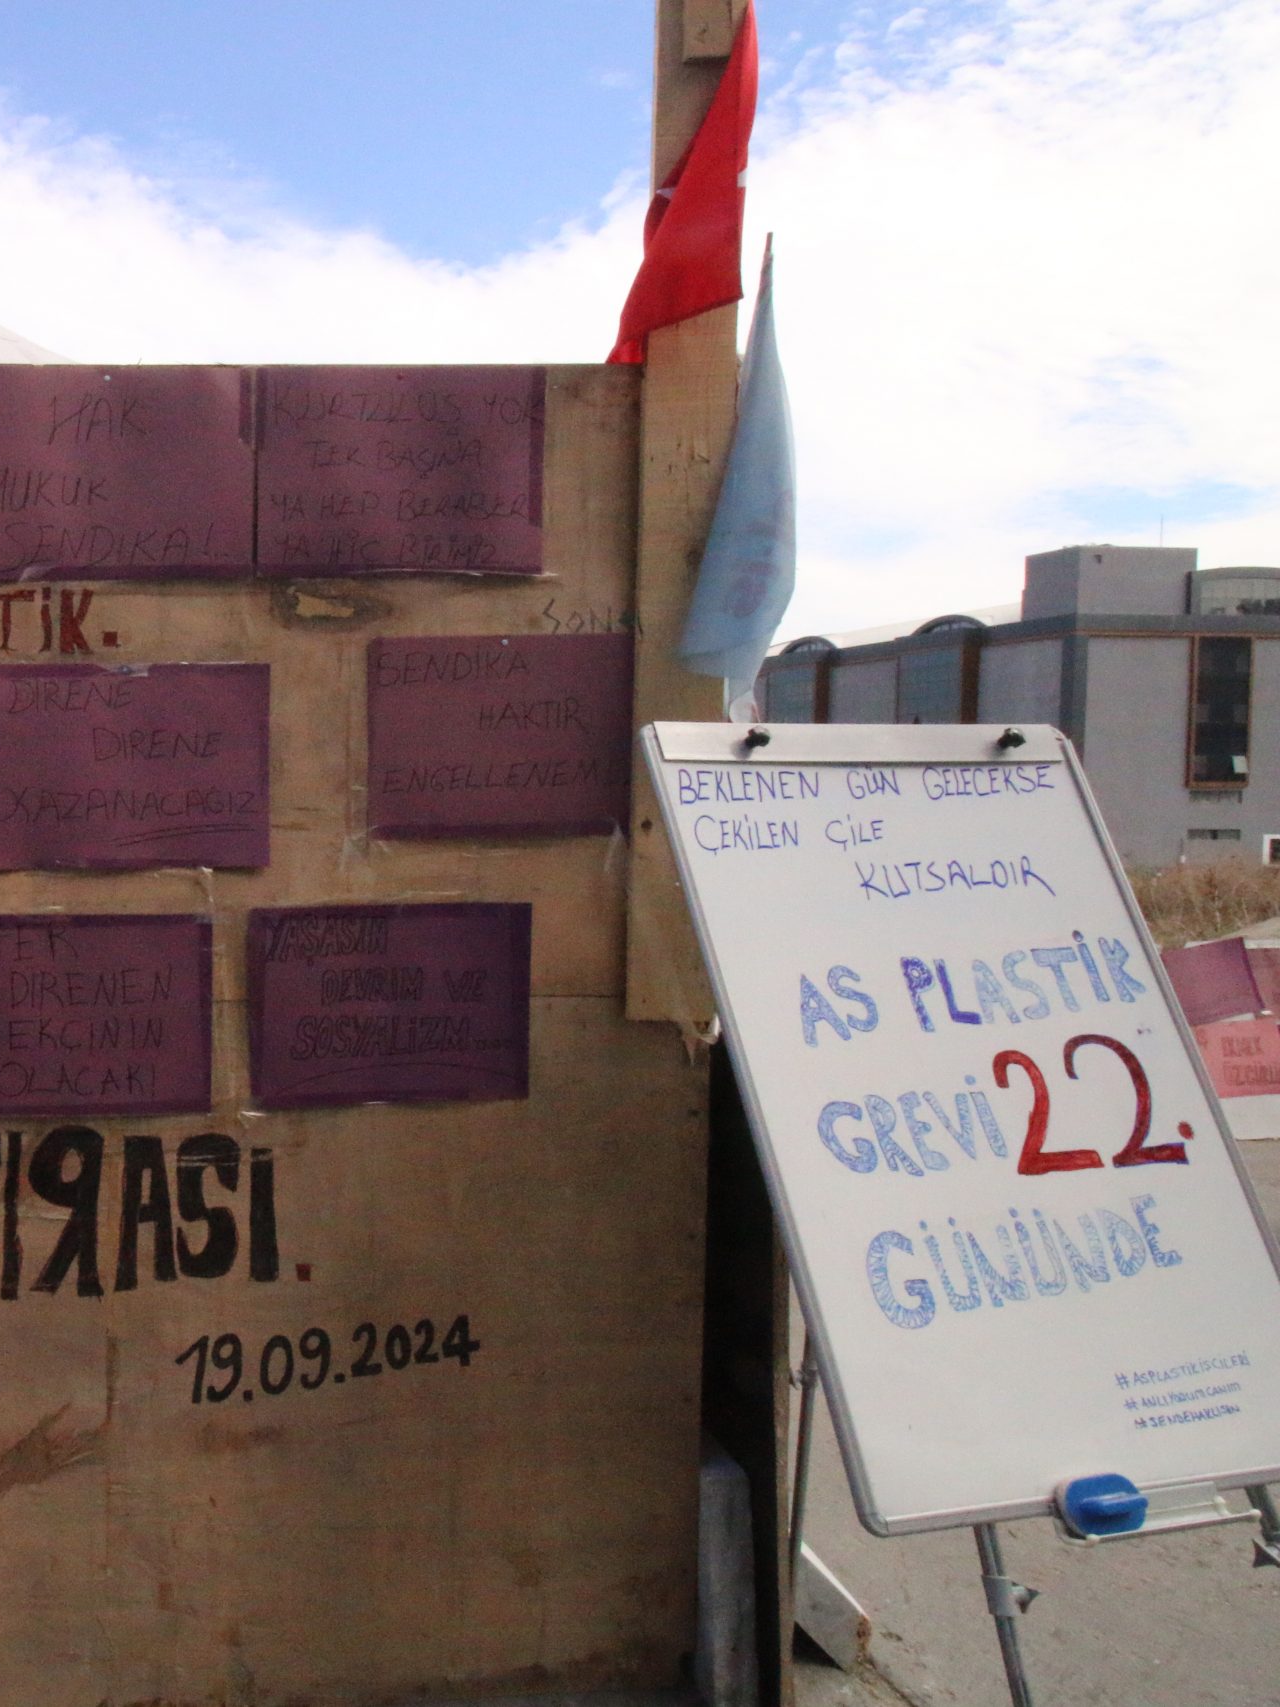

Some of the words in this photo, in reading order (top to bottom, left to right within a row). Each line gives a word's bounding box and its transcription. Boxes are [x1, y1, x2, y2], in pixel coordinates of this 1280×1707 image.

[47, 392, 150, 445] HAK
[483, 393, 545, 425] YOK
[306, 439, 364, 470] TEK
[271, 493, 305, 521] YA
[320, 491, 379, 519] HEP
[397, 488, 528, 522] BERABER
[274, 533, 309, 563] YA
[478, 697, 590, 731] HAKTIR
[678, 769, 820, 805] BEKLENEN
[846, 766, 901, 797] GÜN
[923, 764, 1055, 801] GELECEKSE
[855, 855, 1056, 900] KUTSALDIR
[444, 968, 487, 1003] VE
[800, 964, 879, 1047] AS
[992, 1033, 1194, 1175] 22.
[866, 1193, 1182, 1329] GÜNÜNDE
[174, 1314, 482, 1405] 19.09.2024
